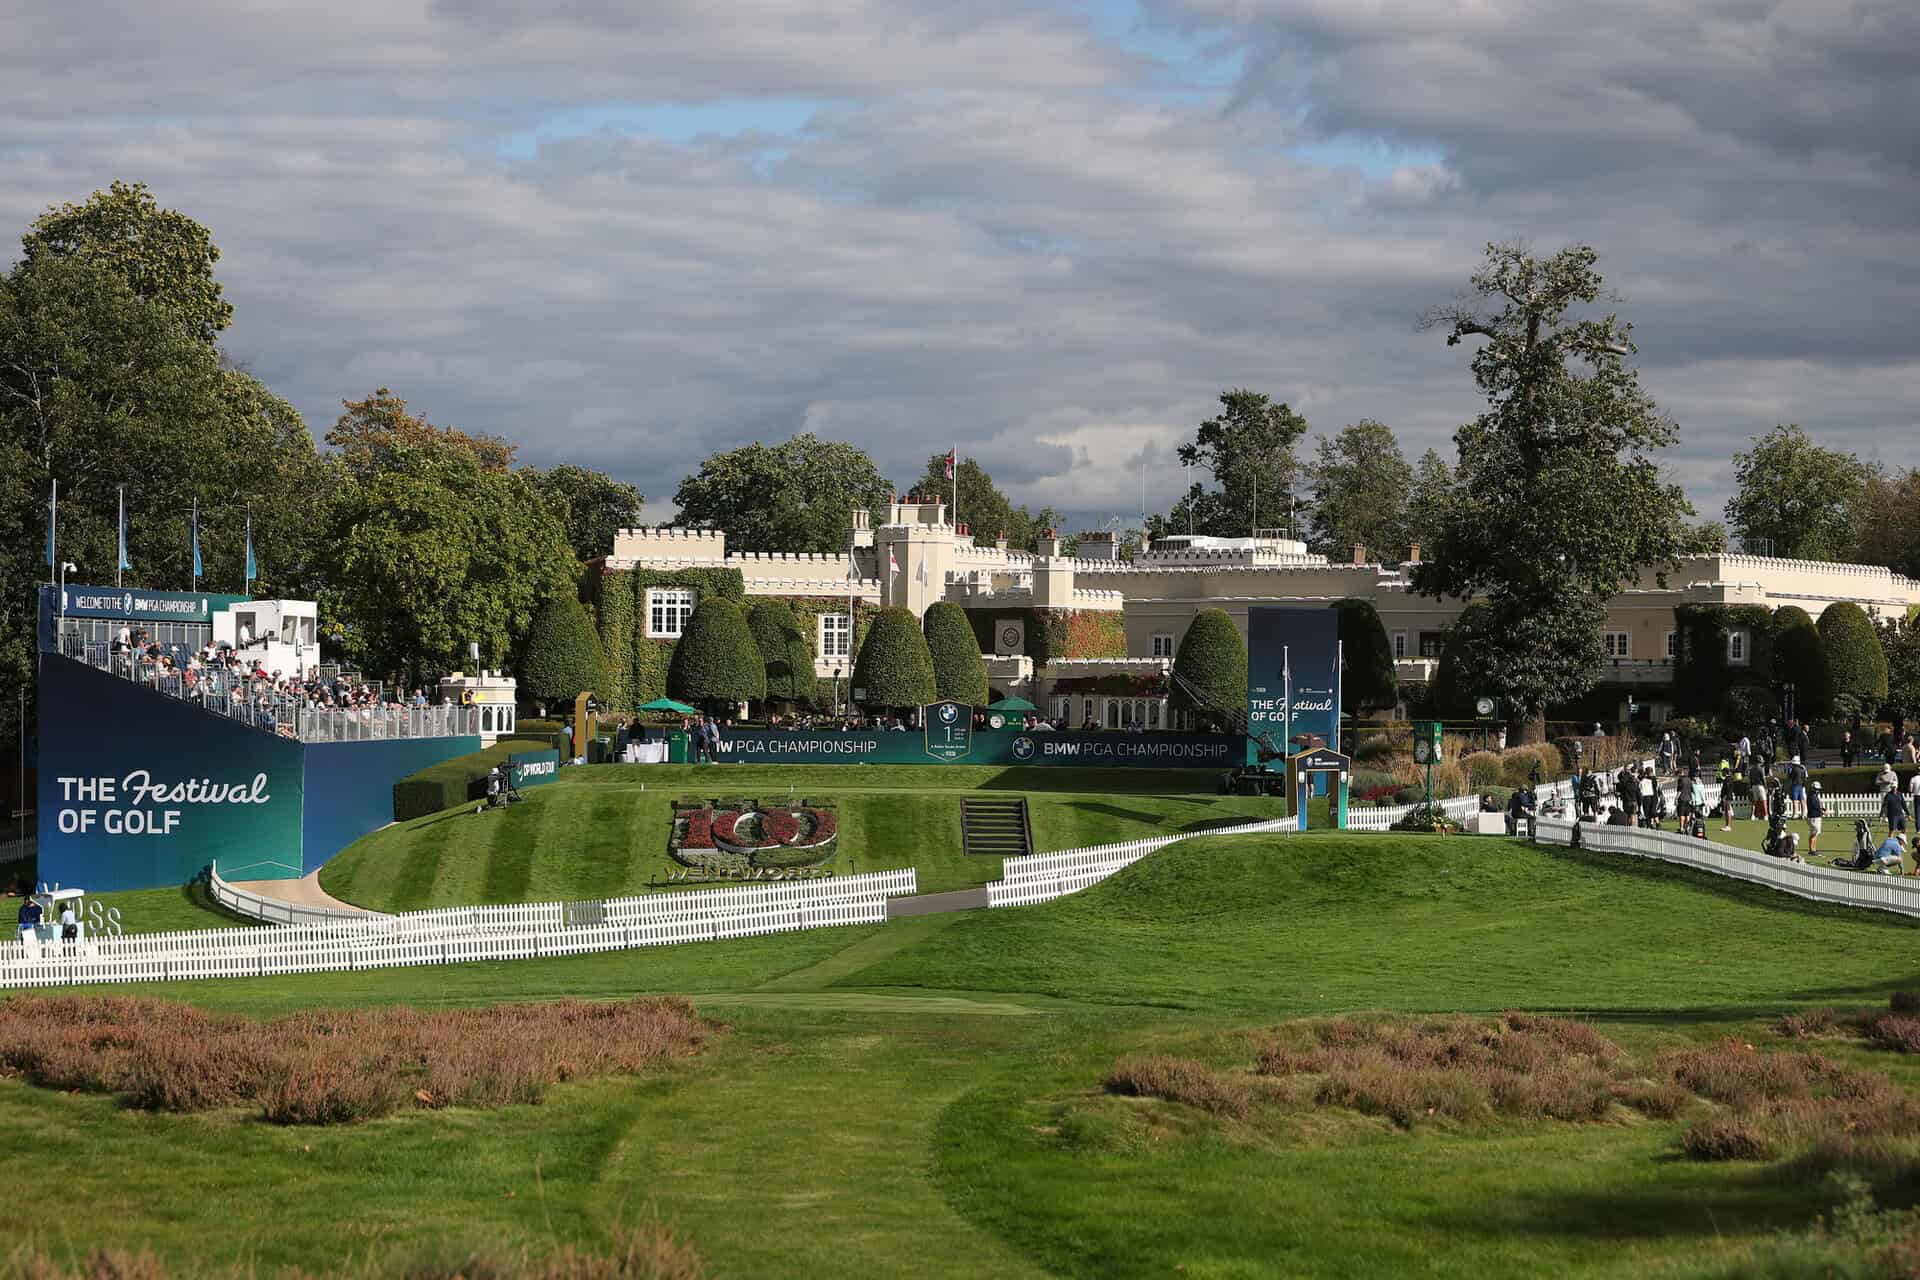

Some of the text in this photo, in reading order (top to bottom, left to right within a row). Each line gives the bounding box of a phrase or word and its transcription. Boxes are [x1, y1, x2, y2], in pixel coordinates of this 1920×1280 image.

[76, 596, 197, 613] WELCOME TO THE BMW PGA CHAMPIONSHIP
[1251, 697, 1333, 711] THE Fstival
[1251, 712, 1299, 721] OF GOF
[736, 740, 765, 753] PGA
[769, 740, 877, 753] CHAMPIONSHIP
[1044, 743, 1228, 757] BMW PGA CHAMPIONSHIP
[57, 769, 270, 806] THE Festival
[57, 809, 181, 834] OF GOLF
